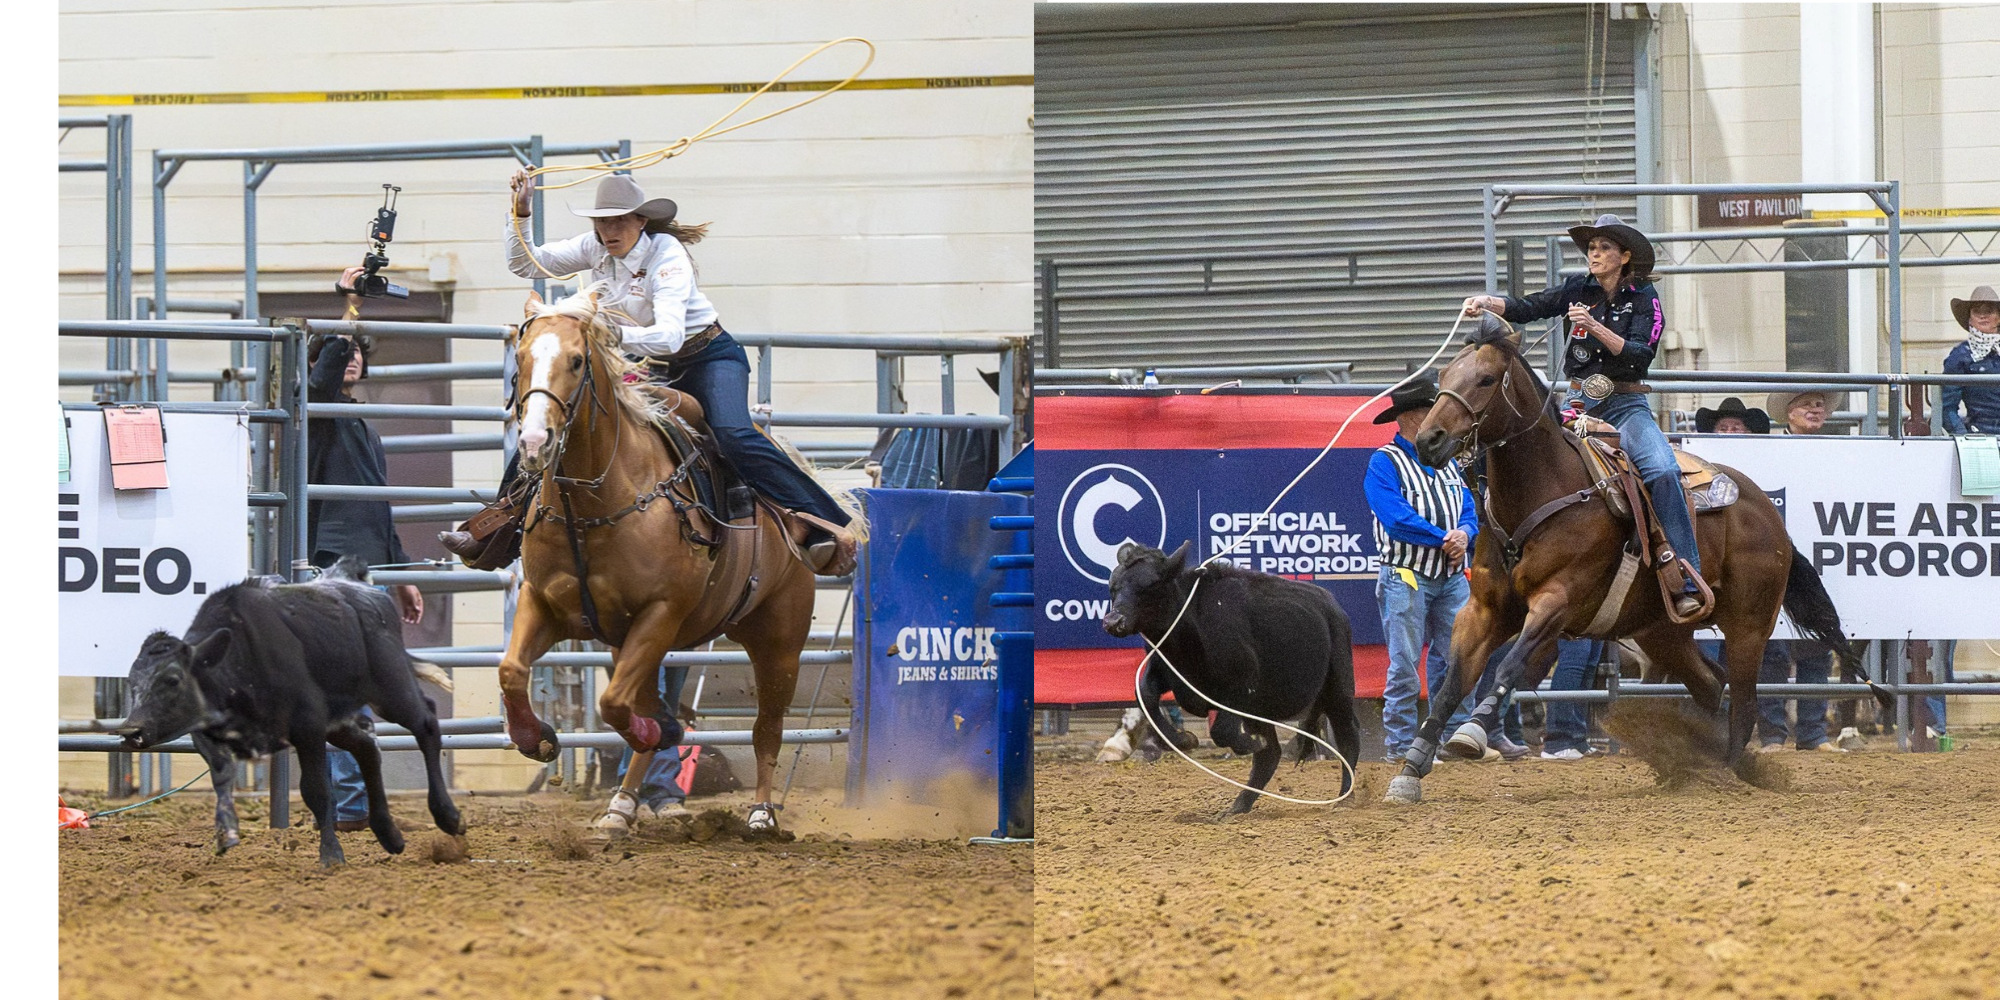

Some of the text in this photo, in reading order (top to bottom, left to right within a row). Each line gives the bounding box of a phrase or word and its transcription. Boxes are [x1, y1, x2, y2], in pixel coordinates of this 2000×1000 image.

[523, 86, 585, 98] ERICKSON
[1719, 198, 1803, 218] WEST PAVILION
[1209, 512, 1347, 533] OFFICIAL
[1813, 502, 2000, 537] WE ARE
[1211, 533, 1362, 554] NETWORK
[896, 626, 997, 662] CINCH
[897, 664, 998, 685] JEANS & SHIRTS
